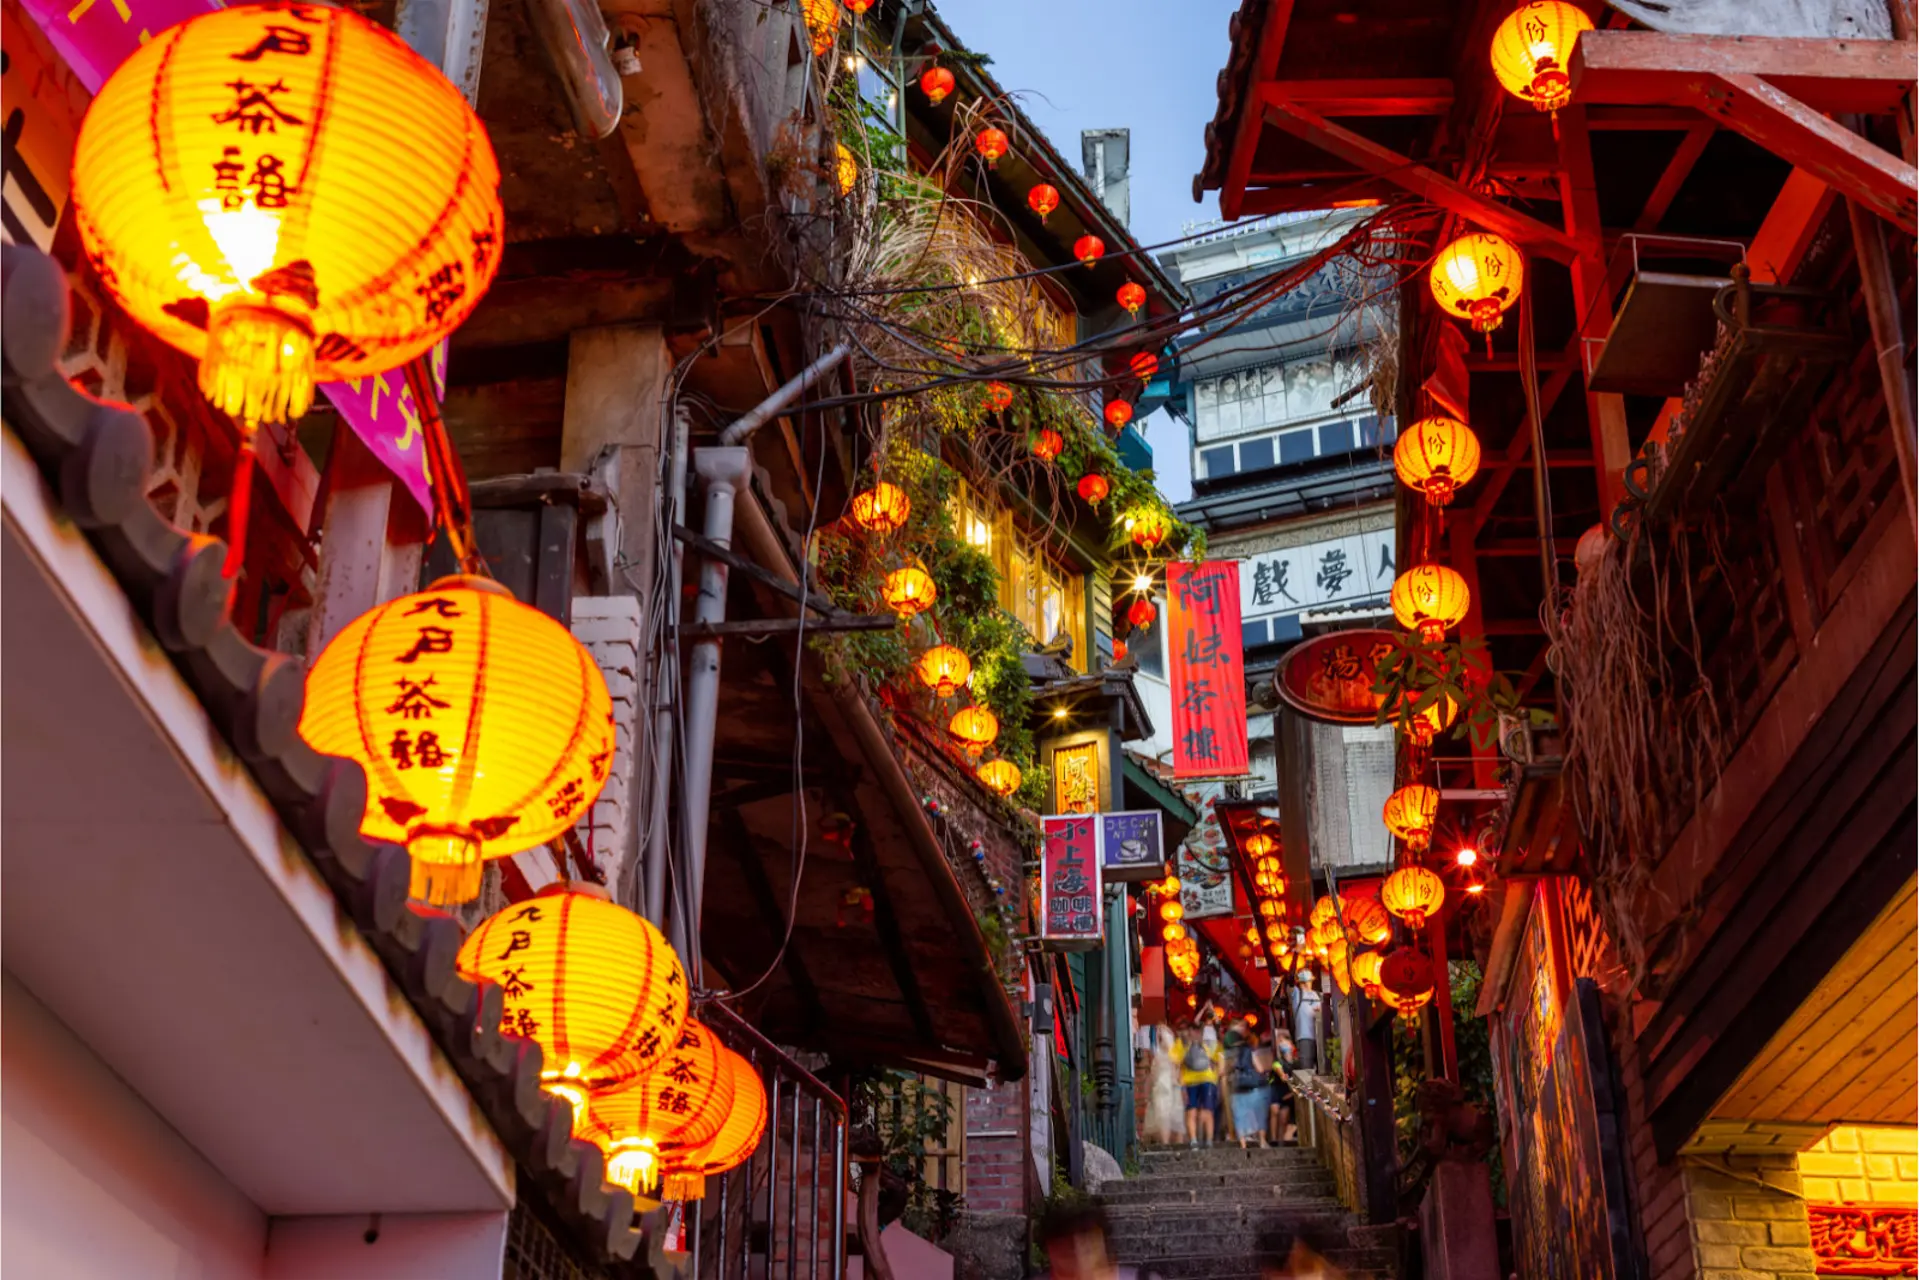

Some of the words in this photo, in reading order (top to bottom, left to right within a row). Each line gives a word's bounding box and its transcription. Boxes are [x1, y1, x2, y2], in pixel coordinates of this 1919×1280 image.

[1176, 570, 1231, 761] 阿妹茶樓
[1053, 822, 1090, 894] 小上海
